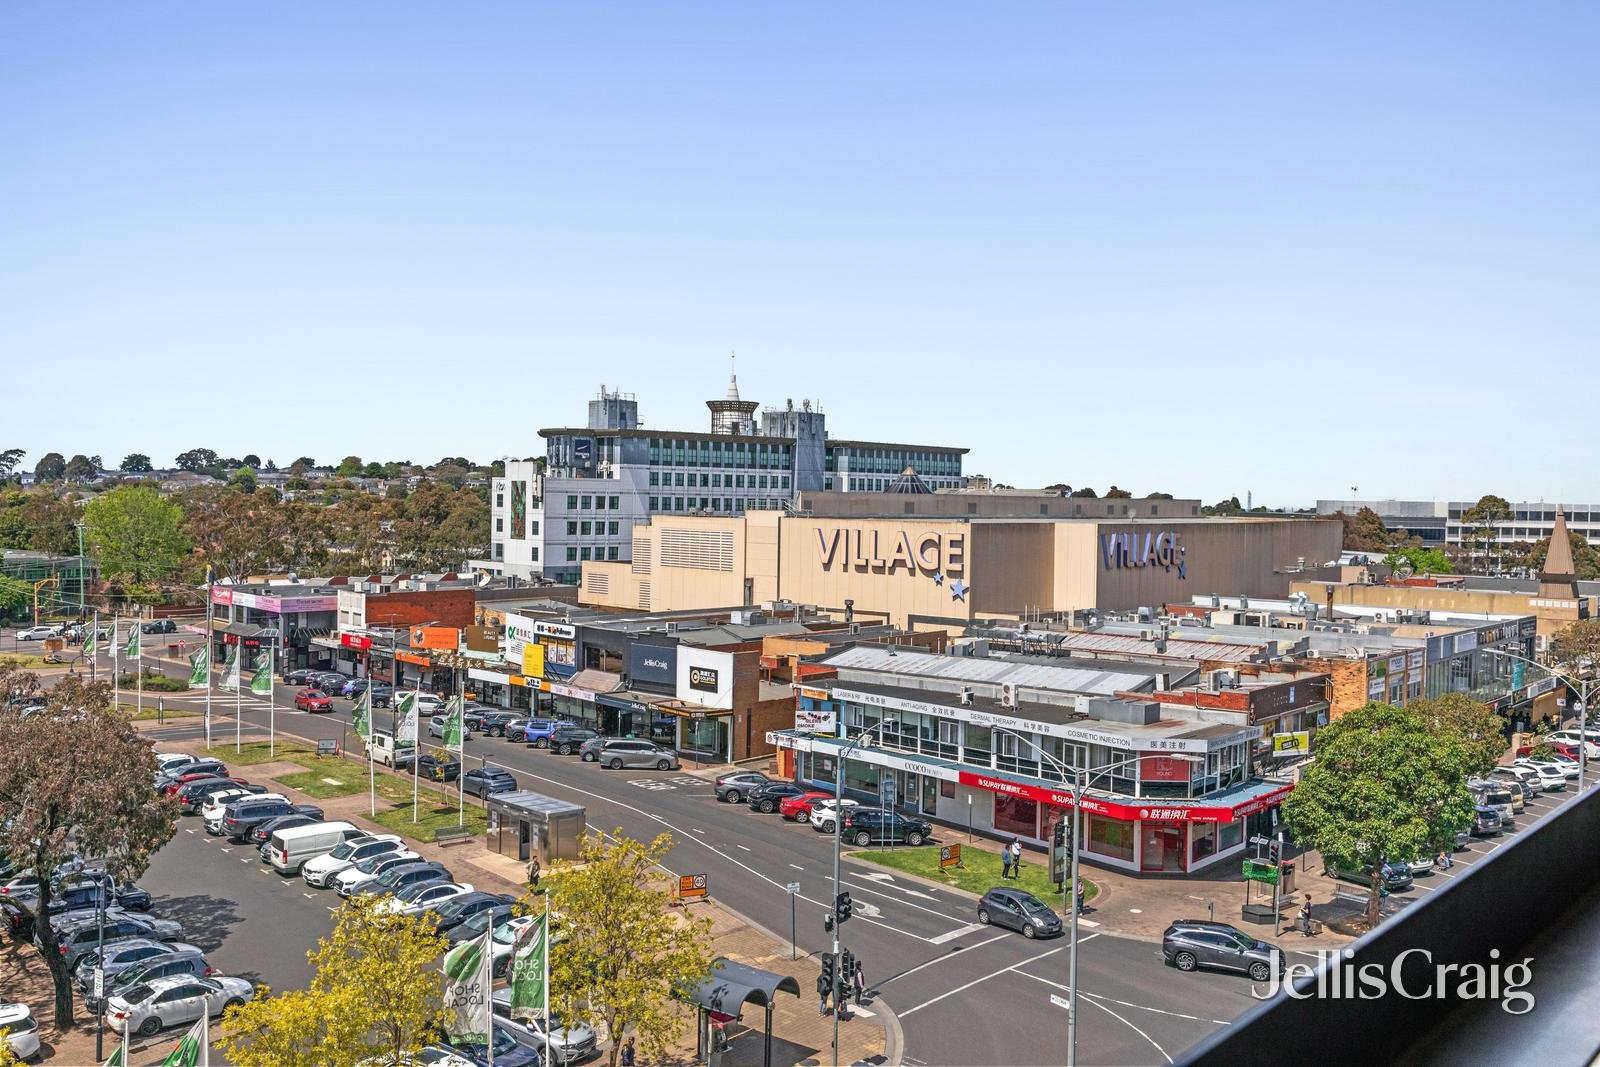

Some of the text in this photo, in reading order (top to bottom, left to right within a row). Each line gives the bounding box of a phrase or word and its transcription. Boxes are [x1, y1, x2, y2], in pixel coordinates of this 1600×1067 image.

[812, 528, 964, 573] VILLAGE
[1100, 529, 1183, 569] VILLAGE
[970, 713, 1017, 726] DERMAL THERAPY
[1067, 729, 1131, 747] COSMETIC INJECTION
[1150, 740, 1186, 750] 医美注射
[982, 779, 1002, 790] SUPAY
[1150, 808, 1192, 820] 联通换汇
